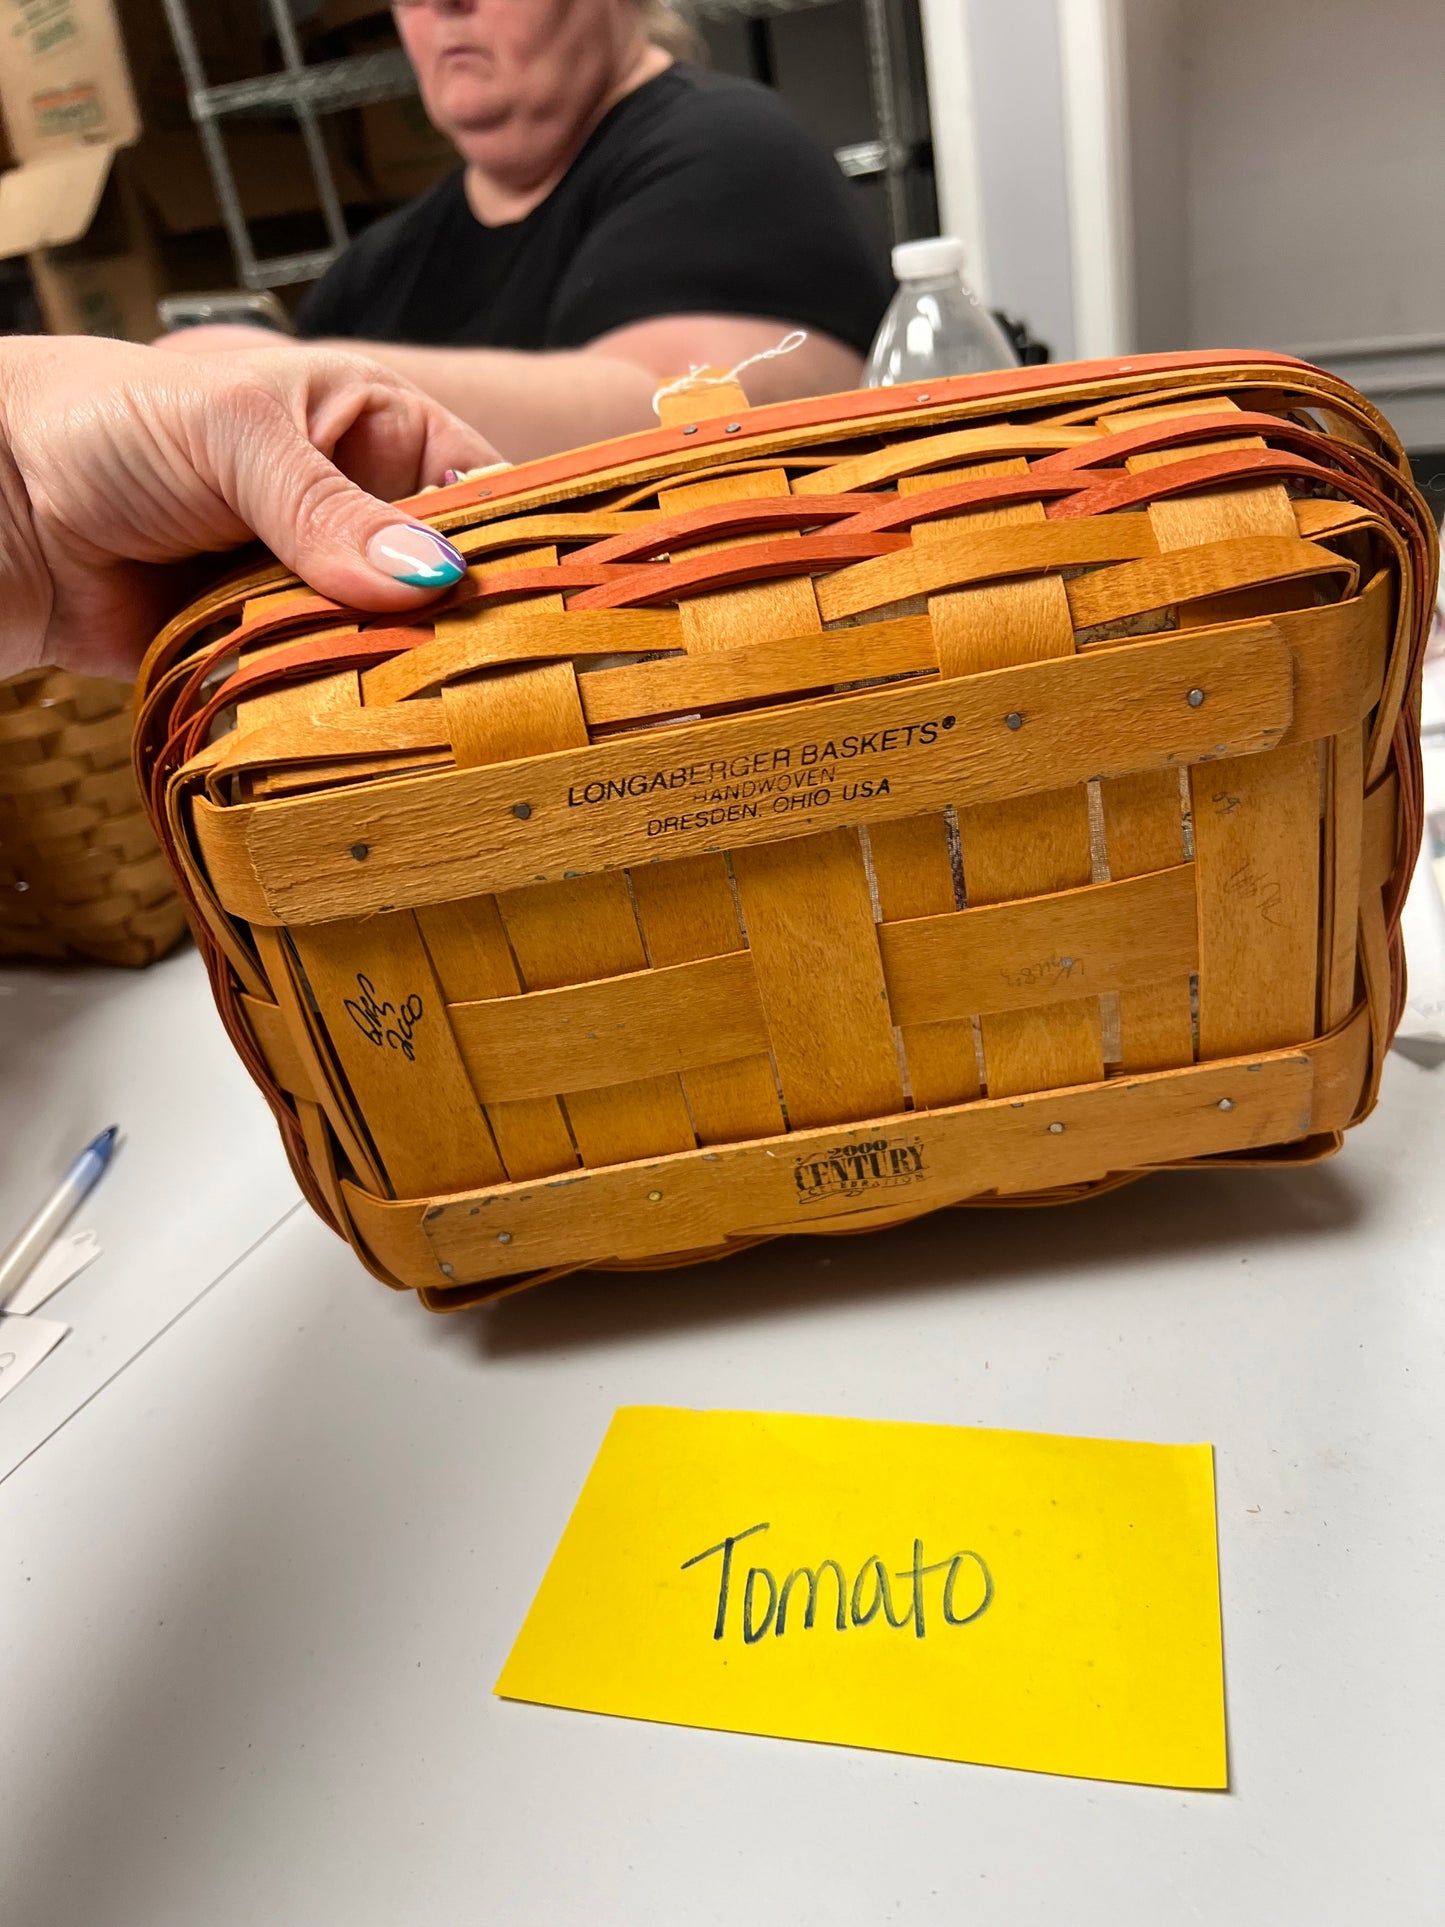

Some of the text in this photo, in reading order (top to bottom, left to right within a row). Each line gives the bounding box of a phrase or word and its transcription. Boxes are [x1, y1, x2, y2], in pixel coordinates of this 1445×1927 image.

[568, 749, 791, 808] LONGABERGER
[694, 766, 835, 803] HANDWOVEN
[773, 789, 830, 814] OHIO
[843, 778, 890, 801] USA
[794, 1144, 924, 1191] CENTURY
[828, 1139, 888, 1159] 2000
[808, 1174, 925, 1197] CEEBRATION
[680, 1522, 994, 1645] Tomato
